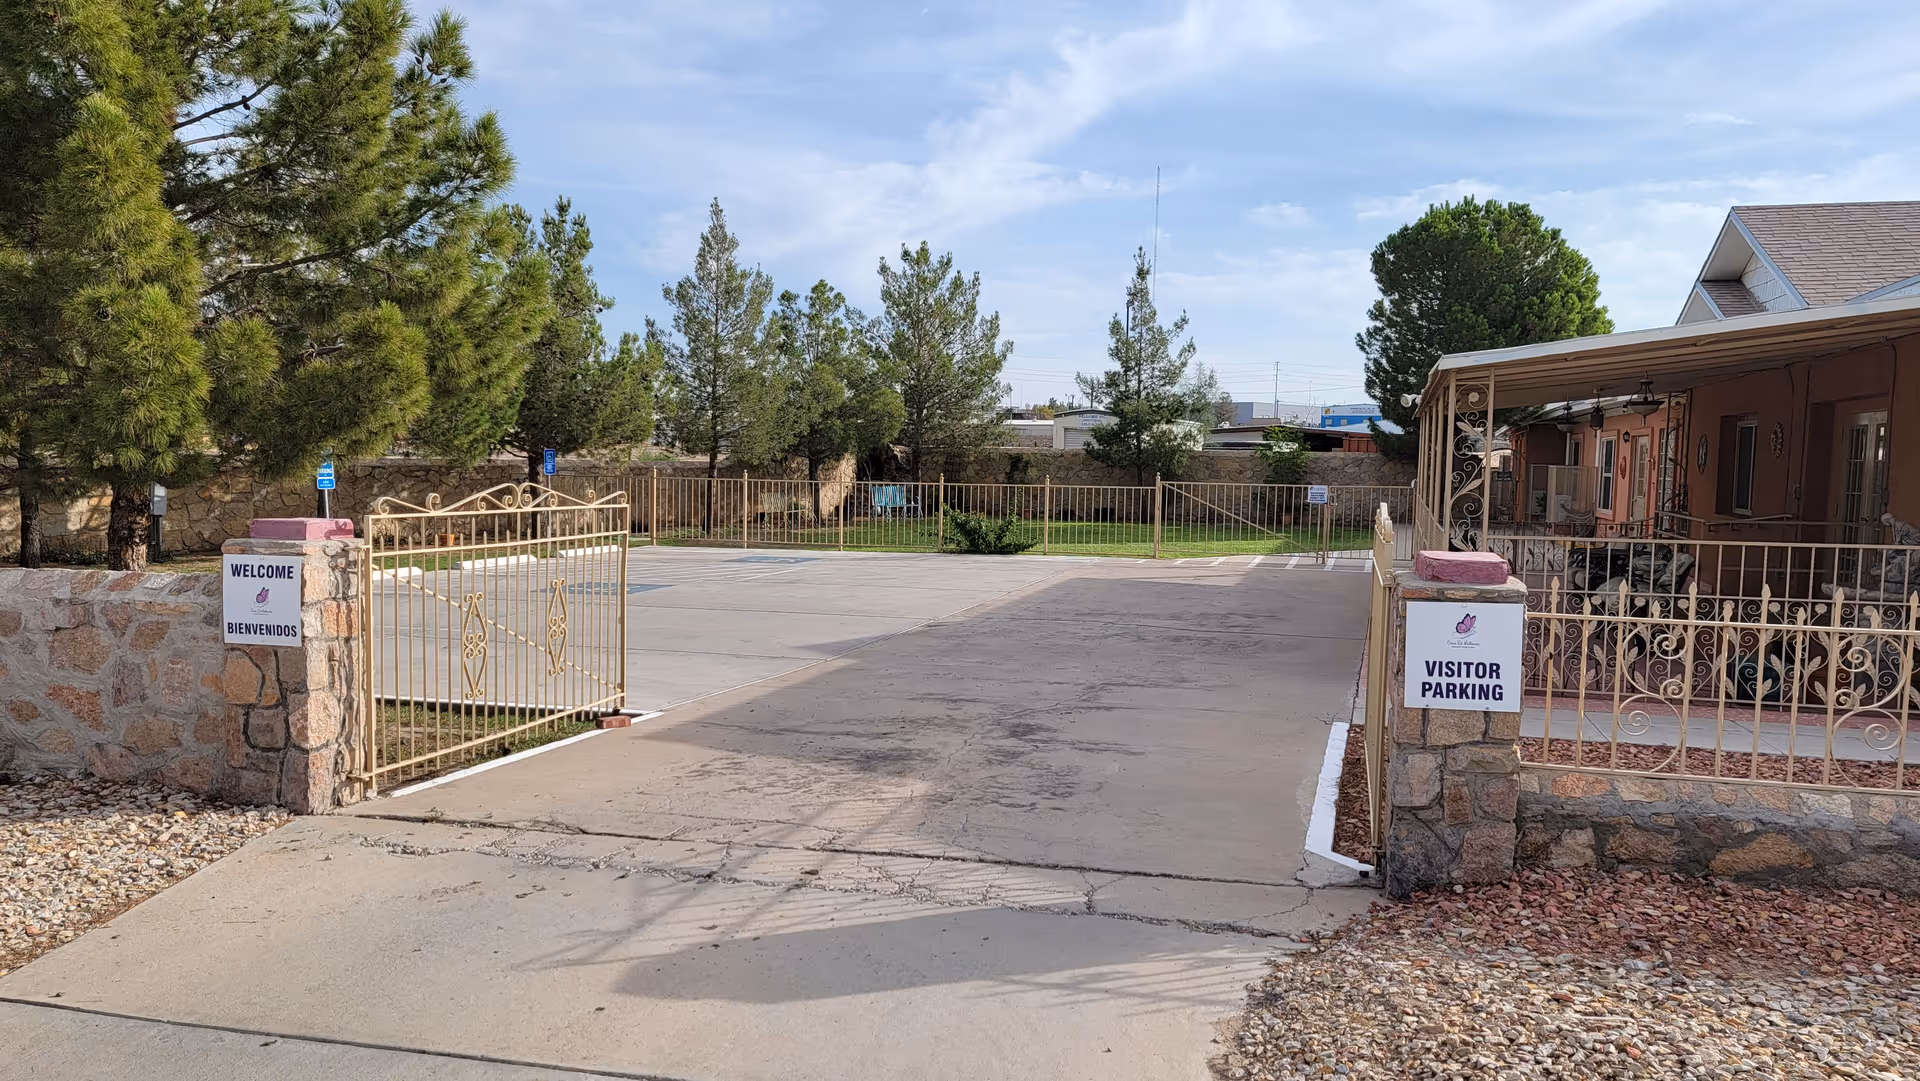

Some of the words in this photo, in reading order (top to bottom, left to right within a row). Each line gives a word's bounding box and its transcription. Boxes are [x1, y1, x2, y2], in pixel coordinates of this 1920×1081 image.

[230, 563, 294, 579] WELCOME
[227, 622, 297, 638] BIENVENIDOS
[1425, 660, 1501, 680] VISITOR
[1421, 681, 1504, 701] PARKING
